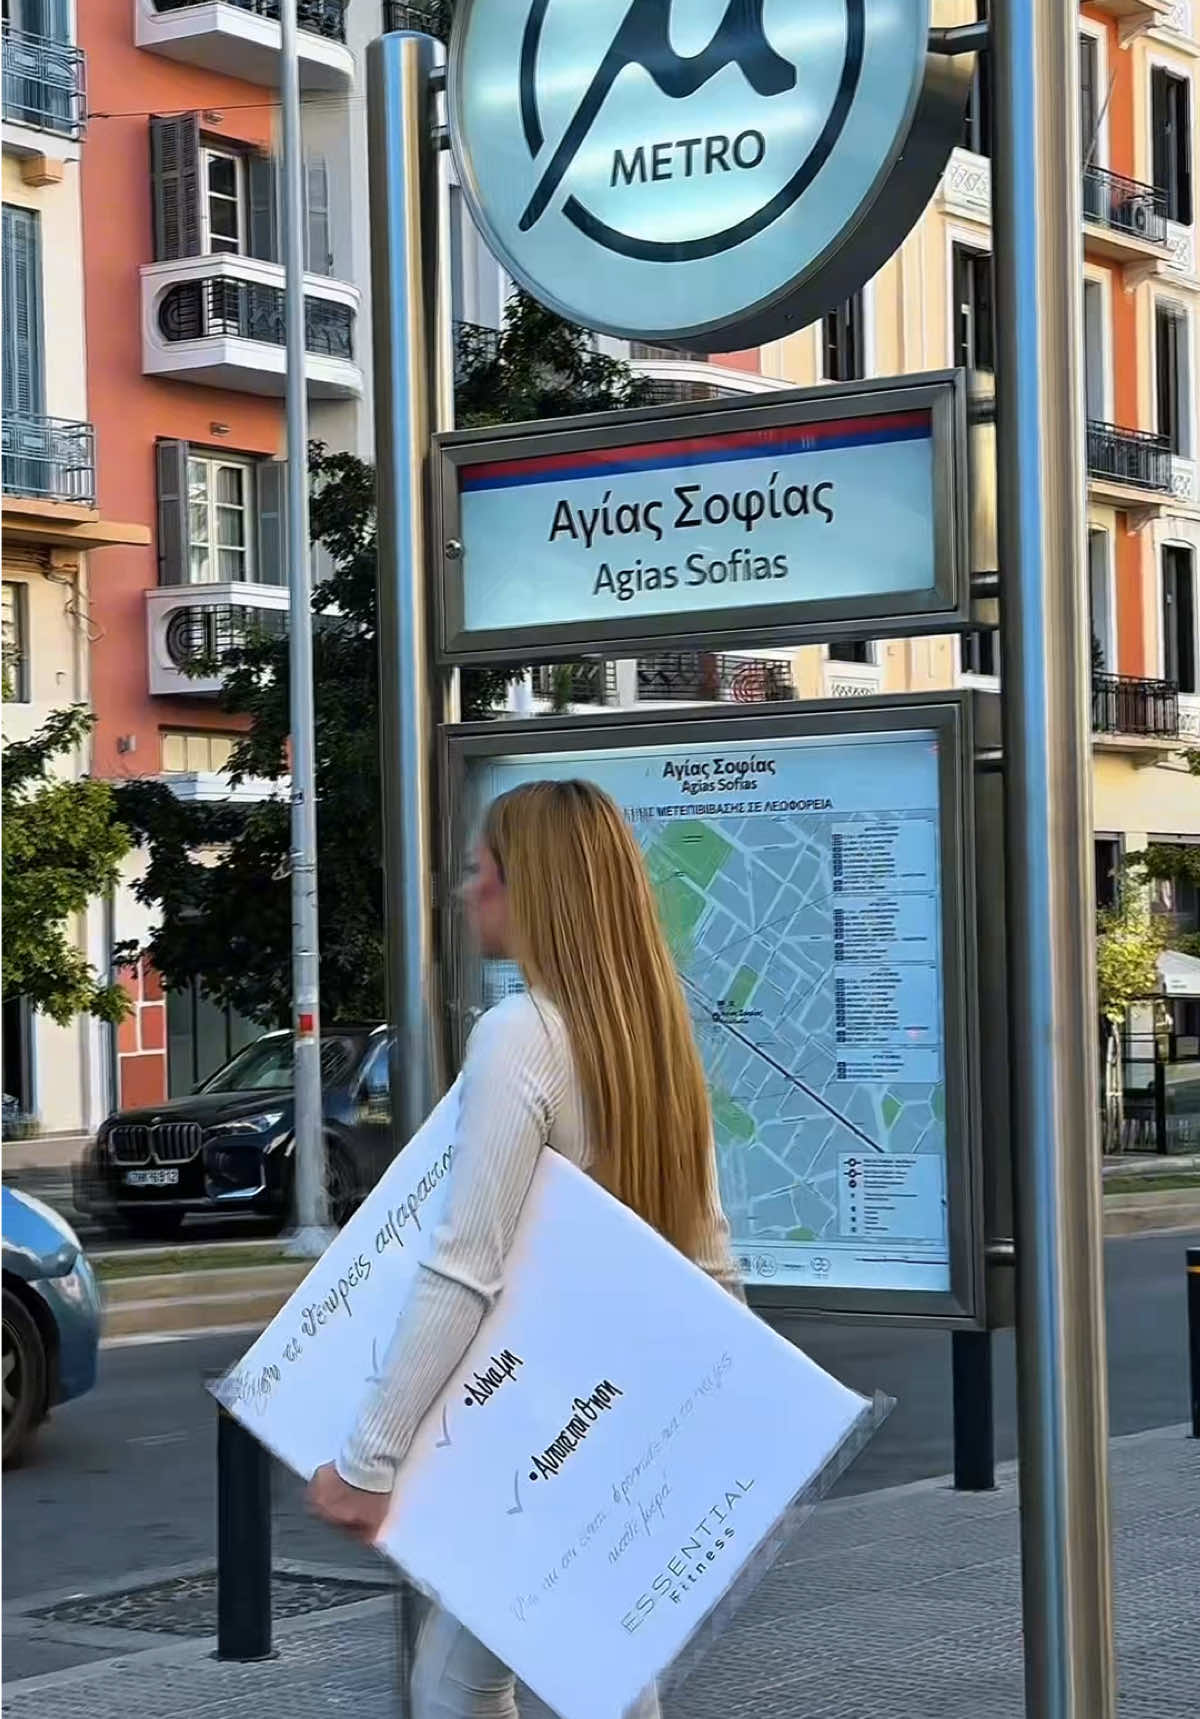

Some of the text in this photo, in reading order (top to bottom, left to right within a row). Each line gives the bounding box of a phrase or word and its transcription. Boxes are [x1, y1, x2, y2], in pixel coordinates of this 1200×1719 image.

[609, 129, 766, 187] METRO
[548, 472, 834, 549] Αγίας Σοφίας
[593, 548, 788, 602] Agias Sofias
[663, 754, 776, 781] Αγίας Σοφίας
[681, 777, 758, 795] Agias Sofias
[657, 802, 744, 817] ΜΕΤΕΠΙΒΙΒΑΣΗΣ
[747, 801, 763, 813] ΣΕ
[764, 798, 833, 812] ΛΕΩΦΟΡΕΙΑ
[620, 1479, 754, 1633] ESSENTIAL
[670, 1527, 736, 1604] Fitness
